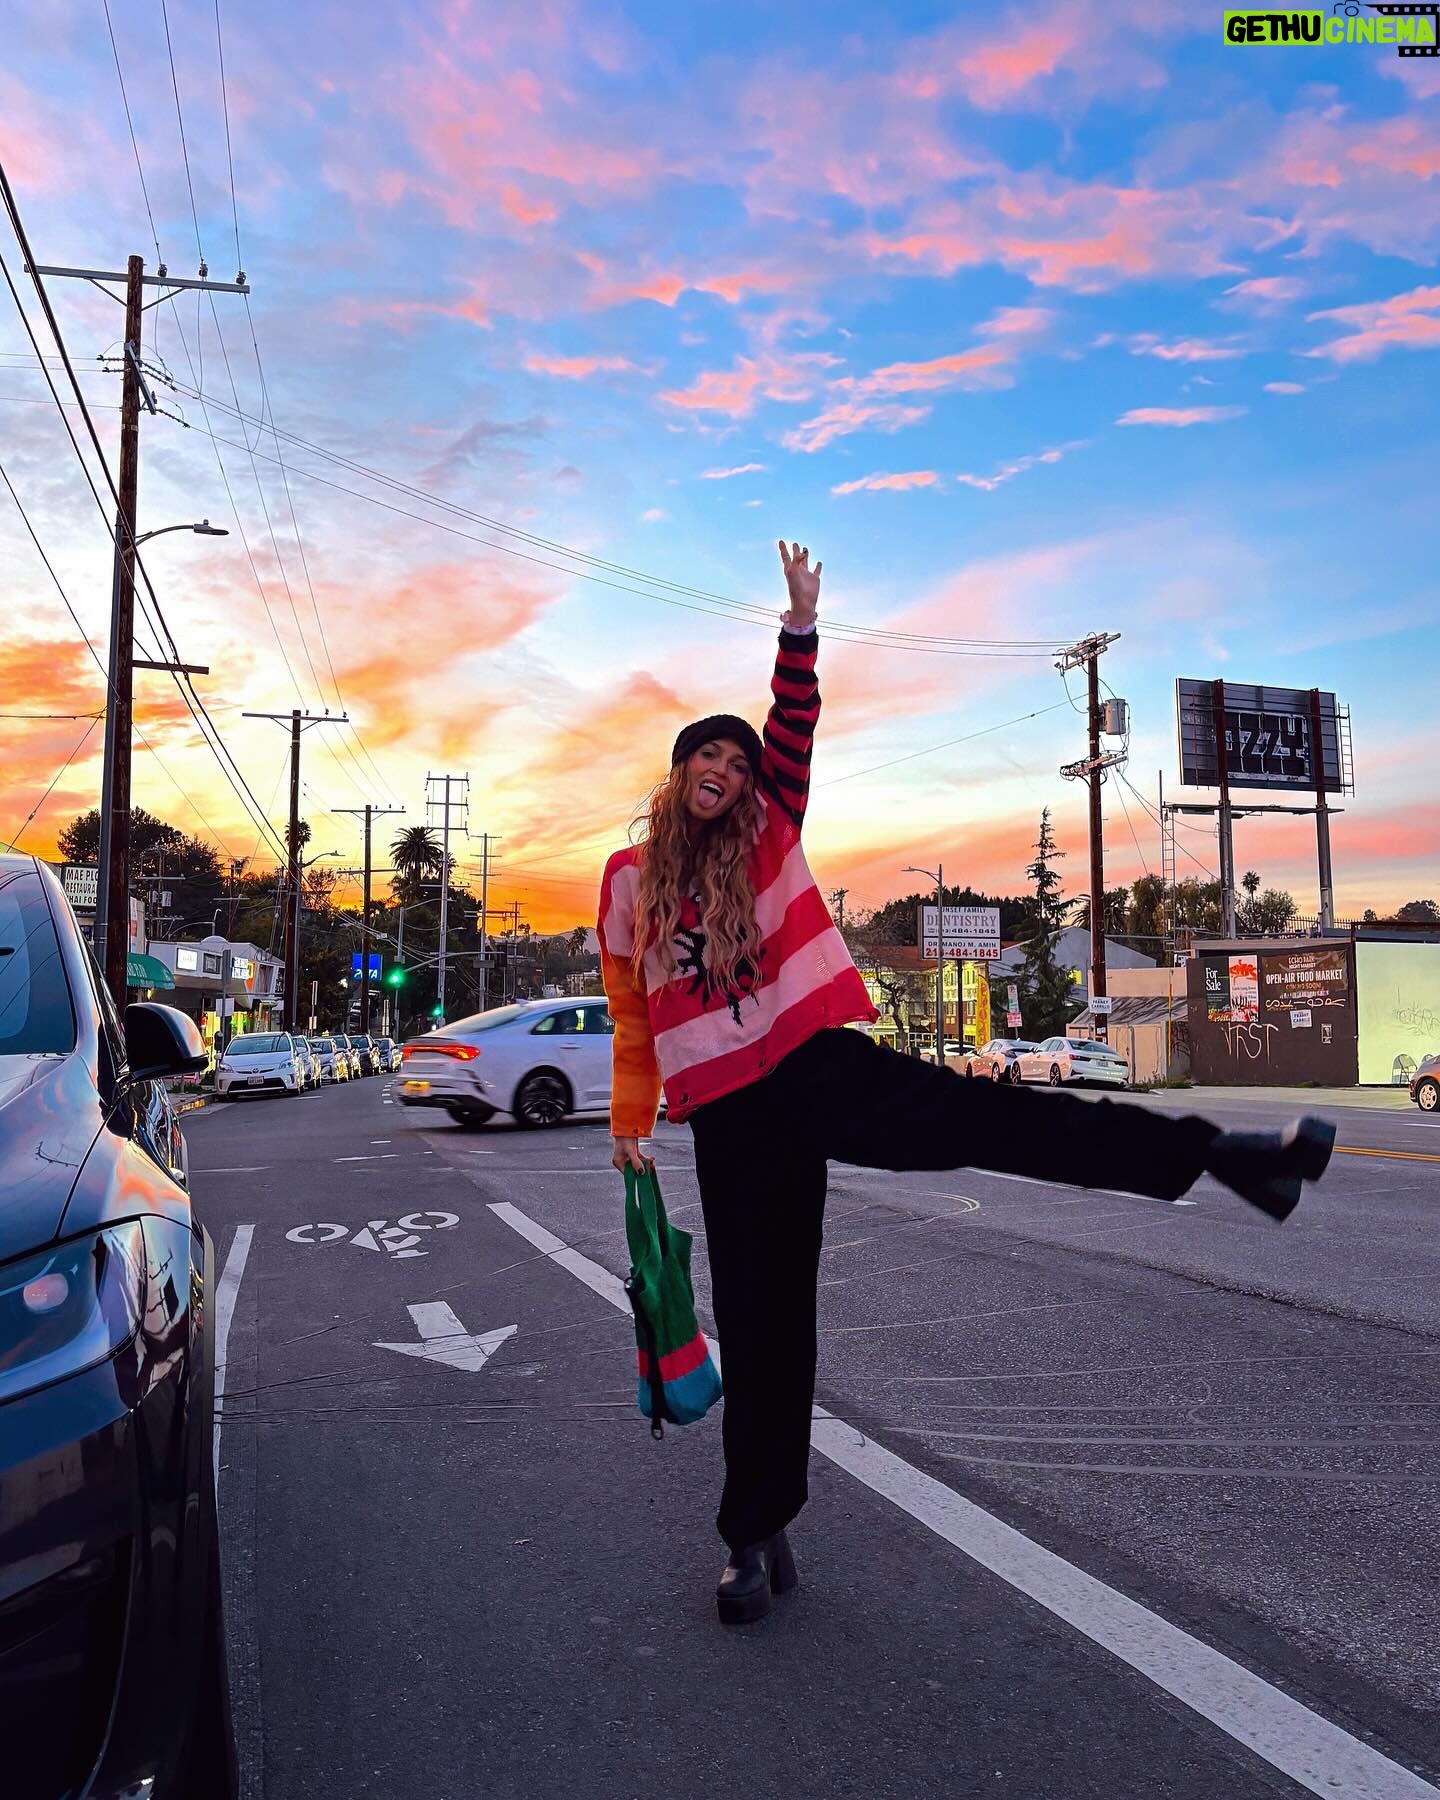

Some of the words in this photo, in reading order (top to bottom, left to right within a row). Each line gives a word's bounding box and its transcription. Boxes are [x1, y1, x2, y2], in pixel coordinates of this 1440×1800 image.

[66, 869, 83, 880] MAE
[1205, 967, 1218, 979] For
[1266, 972, 1296, 985] OPEN-AIR
[1297, 970, 1314, 983] FOOD
[1315, 968, 1343, 981] MARKET
[1205, 979, 1221, 990] Sale
